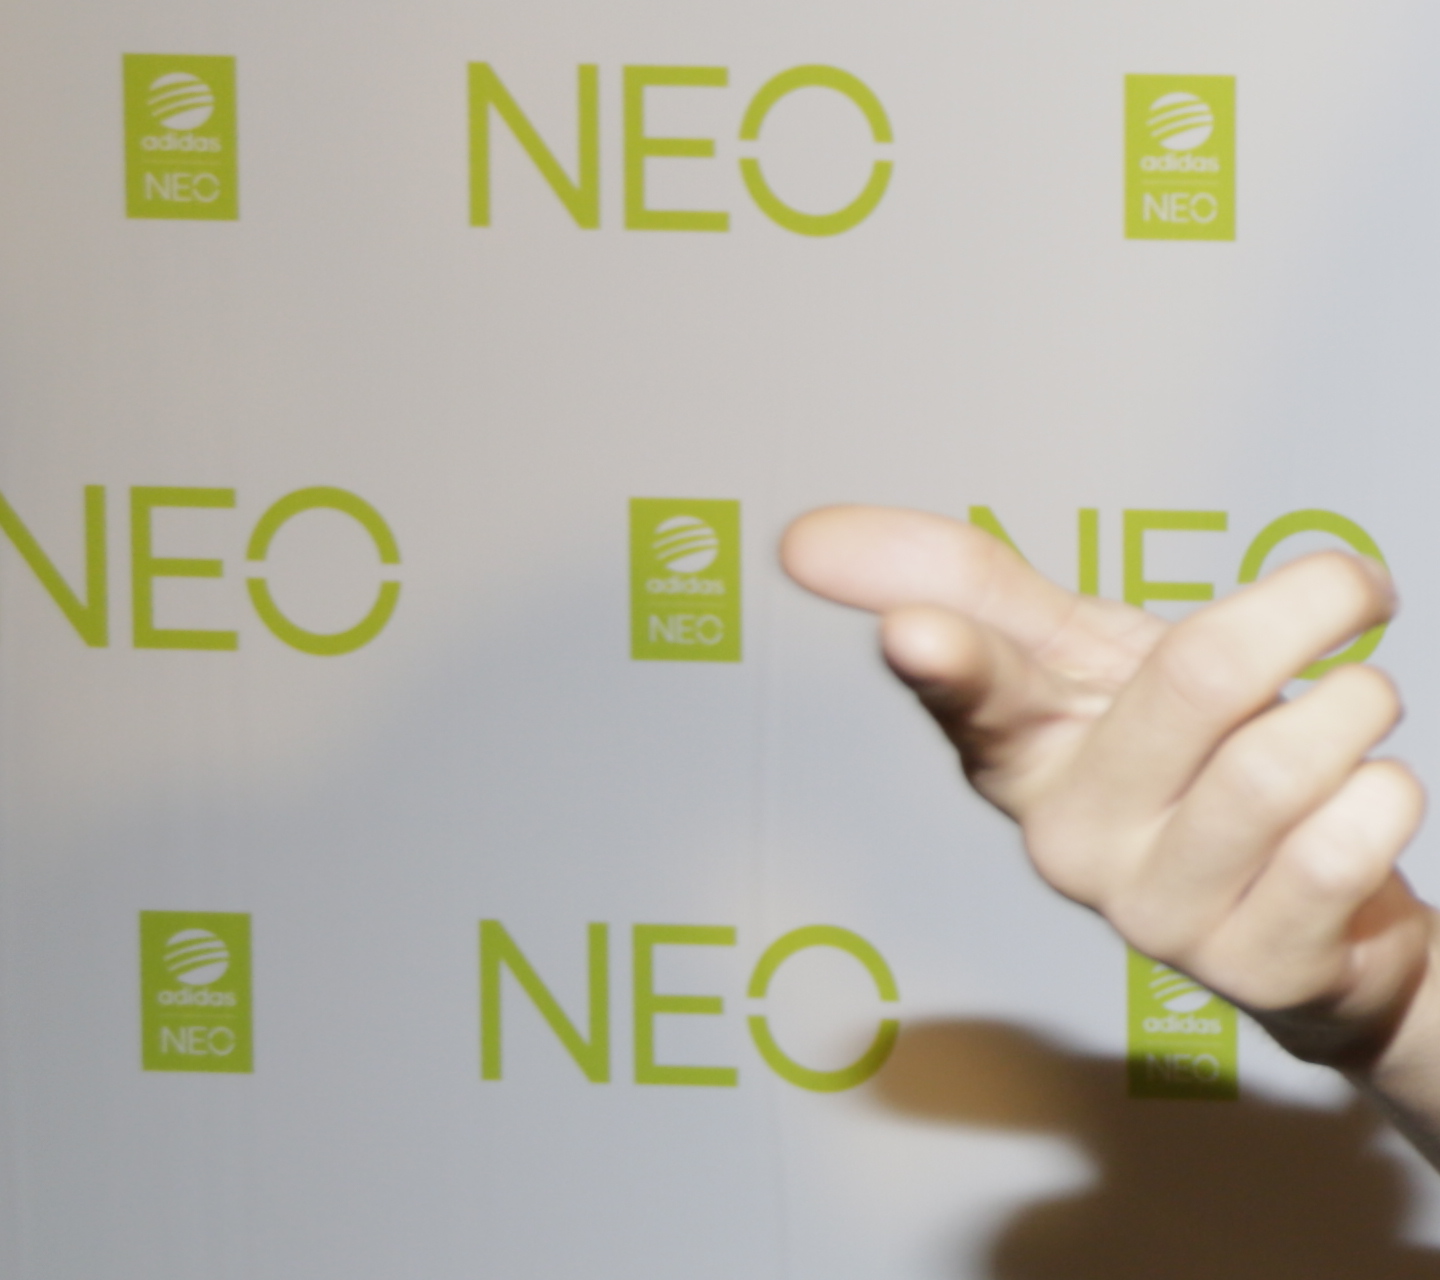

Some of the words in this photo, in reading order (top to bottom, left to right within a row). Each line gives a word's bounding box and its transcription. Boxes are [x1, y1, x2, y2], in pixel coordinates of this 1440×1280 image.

[139, 130, 220, 152] adidas
[467, 61, 892, 237] NEO
[1139, 152, 1219, 173] adidas
[142, 170, 219, 203] NEO
[1142, 191, 1217, 224] NEO
[0, 484, 400, 657] NEO
[645, 573, 724, 594] adidas
[648, 612, 722, 645] NEO
[156, 984, 235, 1005] adidas
[479, 919, 901, 1093] NEO
[159, 1023, 234, 1055] NEO
[1142, 1014, 1222, 1035] adidas
[1145, 1052, 1220, 1083] NEO
